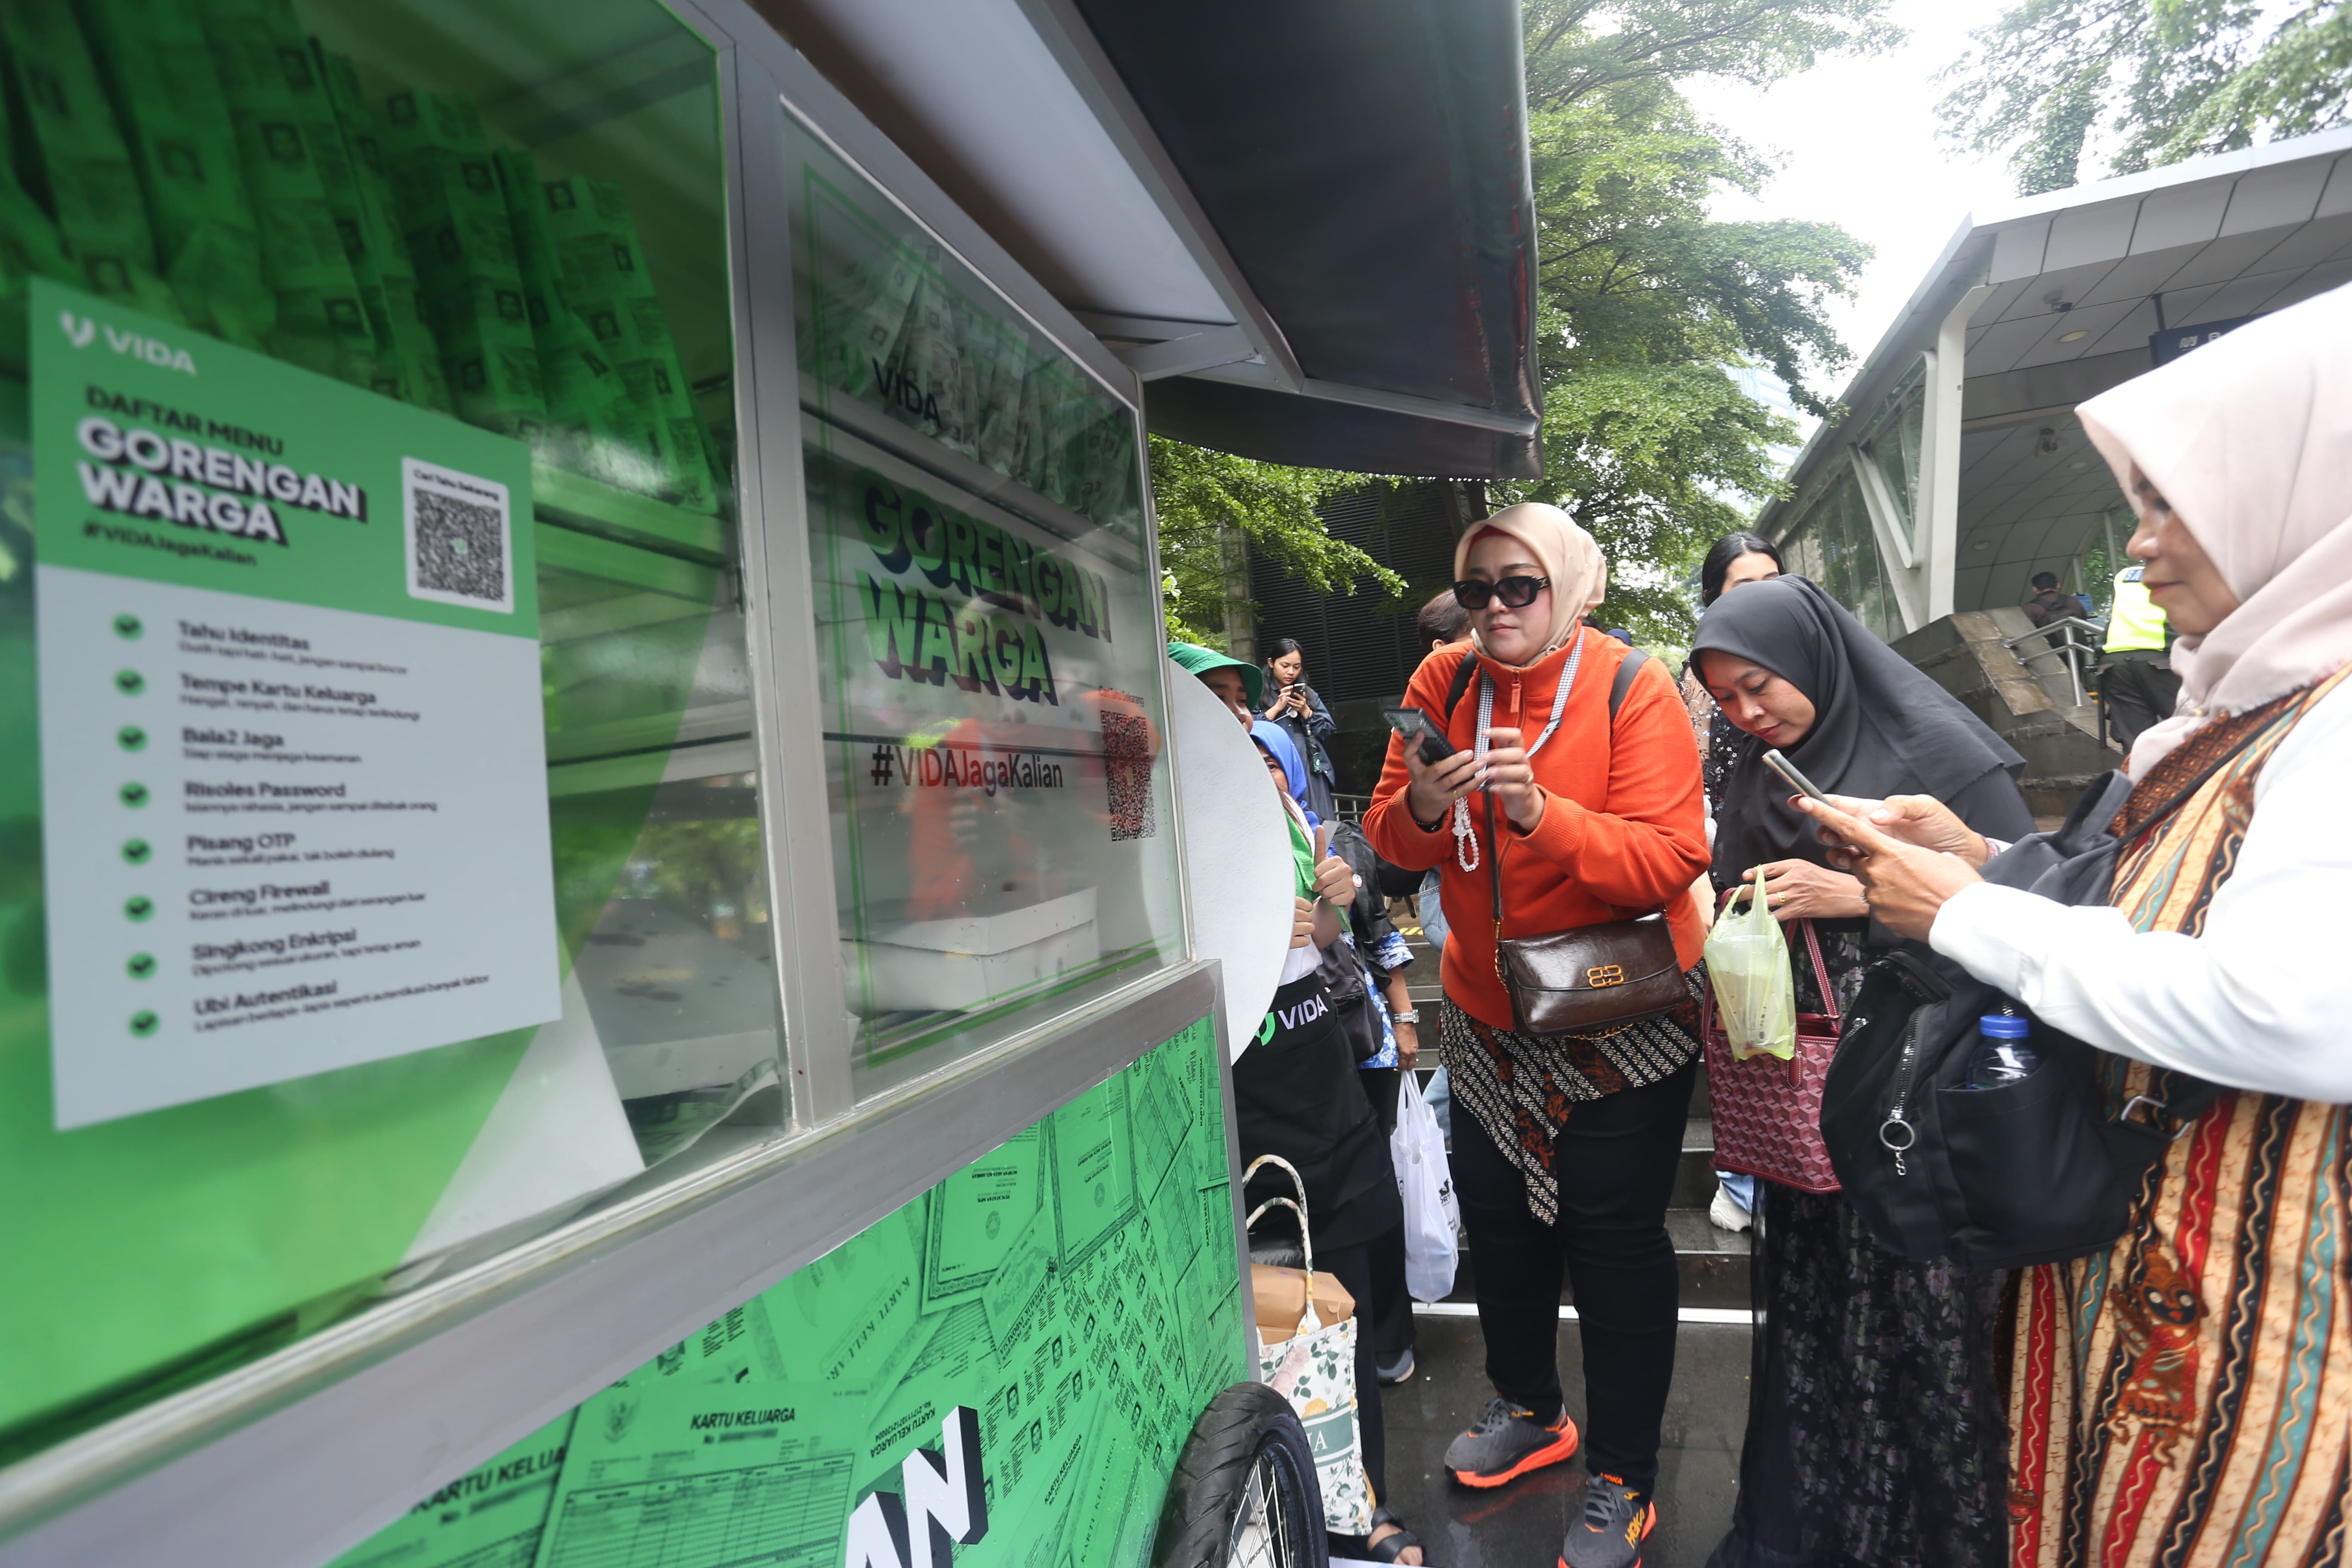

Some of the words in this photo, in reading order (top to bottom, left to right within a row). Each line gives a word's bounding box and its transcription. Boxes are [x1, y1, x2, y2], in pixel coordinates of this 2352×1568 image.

[103, 323, 198, 378] VIDA
[872, 356, 942, 428] VIDA
[86, 386, 203, 435] DAFTAR
[207, 417, 284, 455] MENU
[77, 416, 368, 523] GORENGAN
[77, 461, 289, 546] WARGA
[83, 520, 257, 567] #VIDAJagaKalian
[854, 466, 1112, 643] GORENGAN
[179, 620, 225, 641] Tahu
[230, 628, 310, 650] Identitas
[855, 568, 1058, 706] WARGA
[181, 672, 247, 694] Tempe
[252, 680, 300, 698] Kartu
[304, 684, 376, 706] Keluarga
[182, 728, 238, 745] Bala2
[243, 730, 284, 750] Jaga
[870, 744, 1064, 797] #VIDAJagaKalian
[184, 780, 255, 798] Risoles
[259, 782, 346, 797] Password
[186, 834, 253, 853] Pisang
[257, 833, 296, 848] OTP
[189, 889, 256, 906] Cireng
[260, 880, 330, 901] Firewall
[193, 942, 285, 961] Singkong
[288, 928, 358, 951] Enkripsi
[193, 996, 230, 1016] Ubi
[234, 980, 338, 1010] Autentikasi
[1278, 994, 1328, 1030] VIDA
[690, 1412, 734, 1430] KARTU
[735, 1407, 795, 1426] KELUARGA
[912, 1407, 936, 1431] KARTU
[870, 1424, 912, 1458] KELUARGA
[1045, 1475, 1060, 1505] KARTU
[1059, 1434, 1082, 1476] KELUARGA
[1625, 1507, 1646, 1550] HOKA
